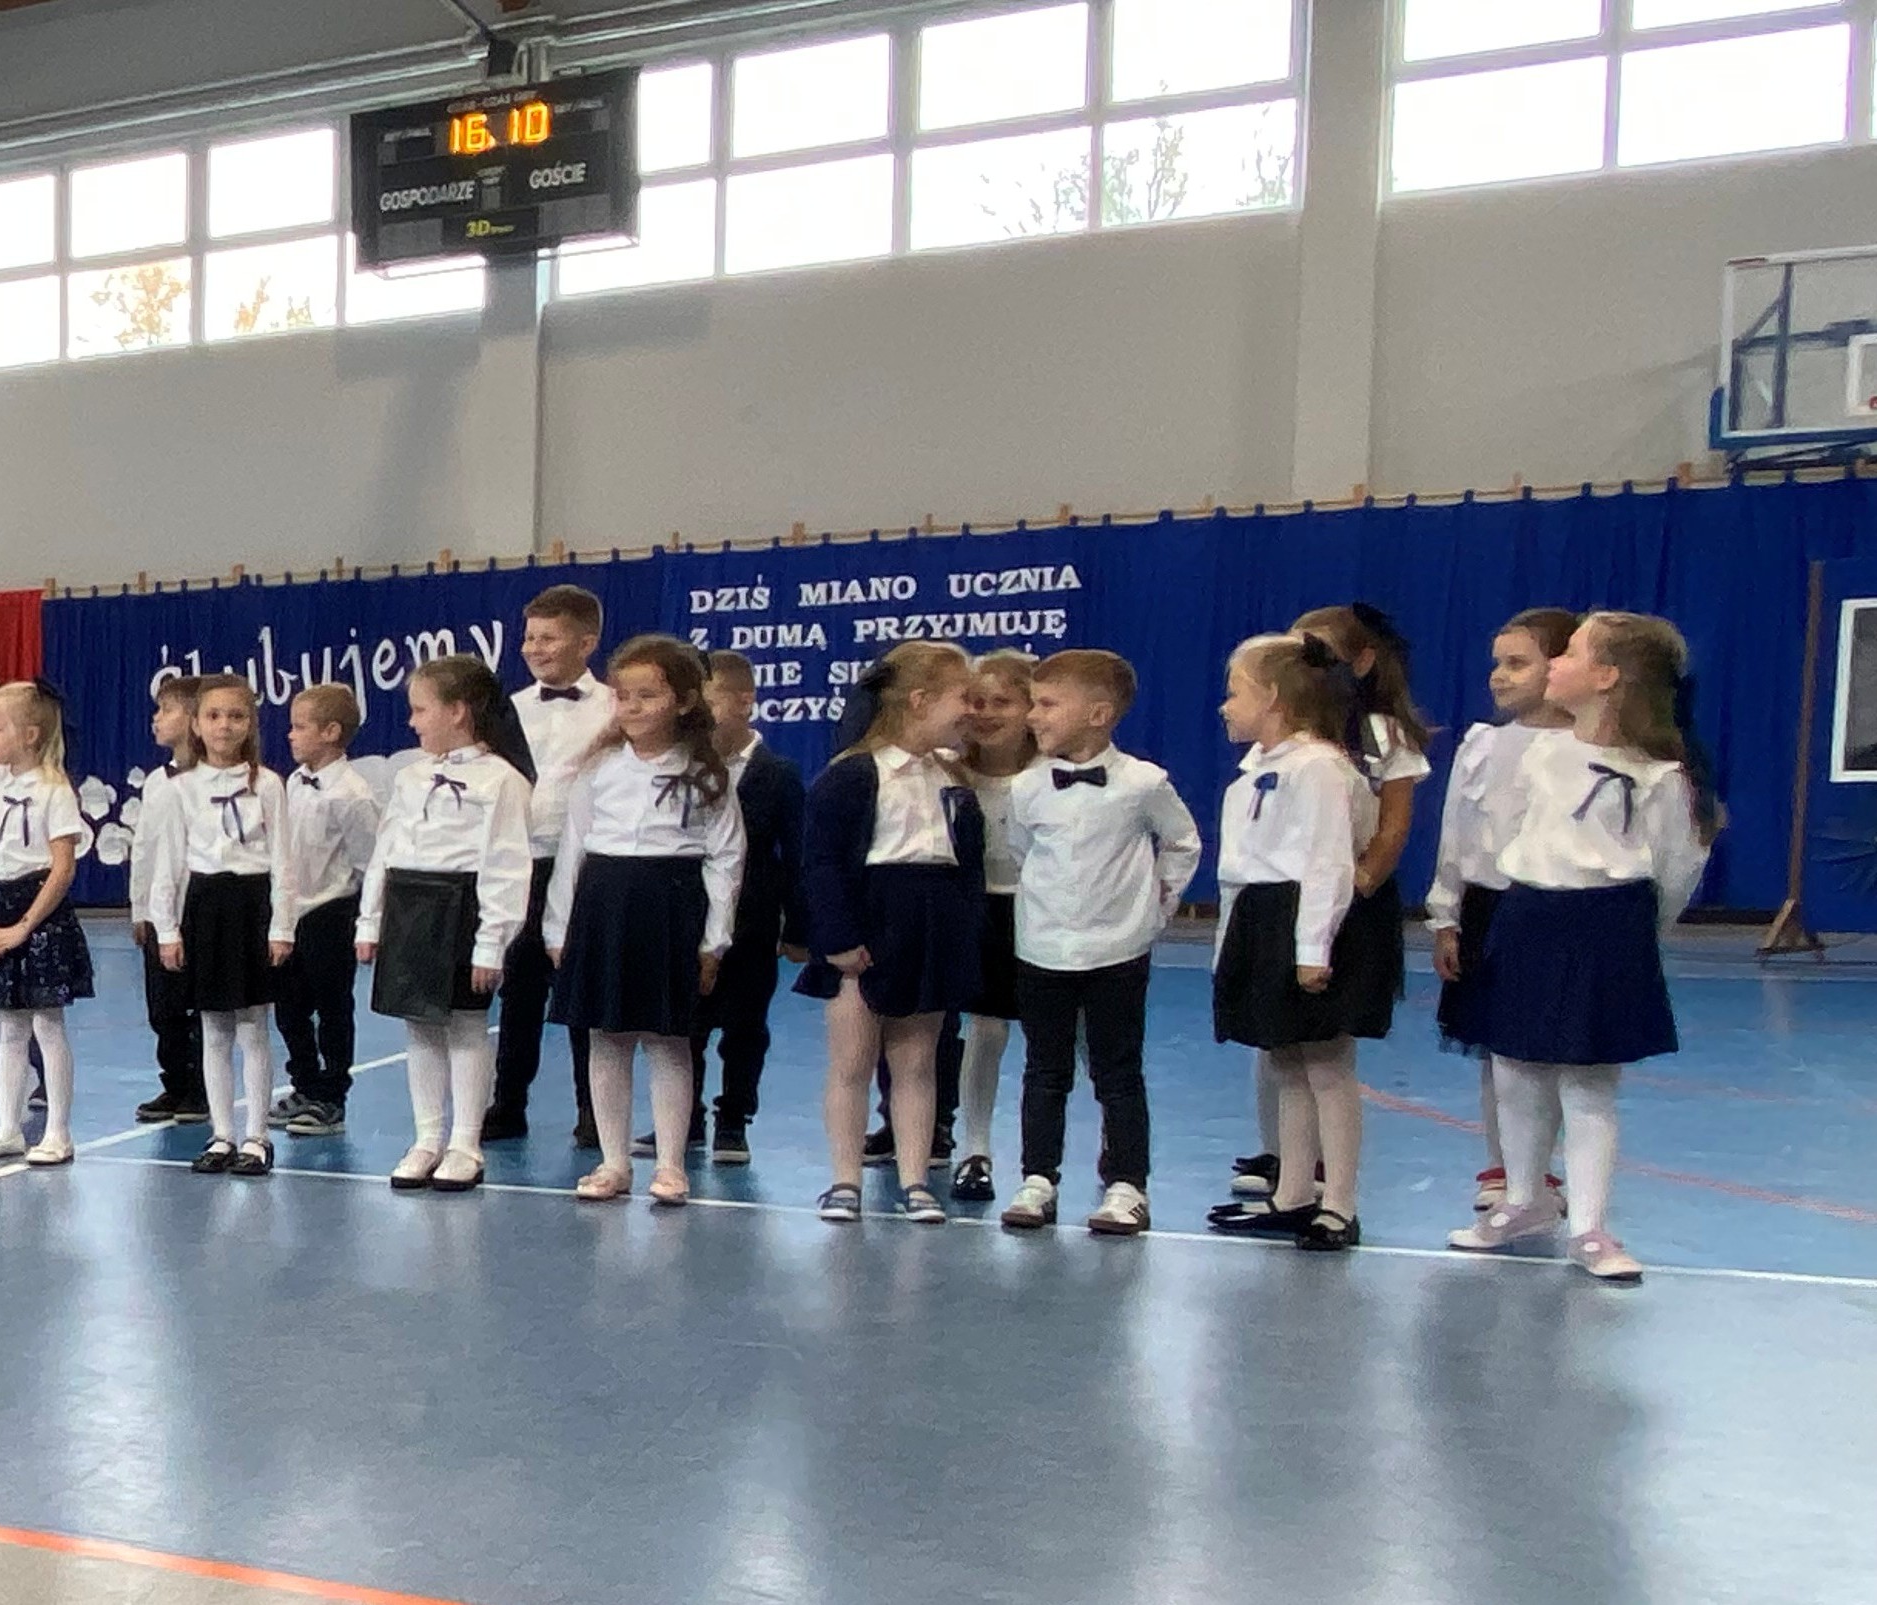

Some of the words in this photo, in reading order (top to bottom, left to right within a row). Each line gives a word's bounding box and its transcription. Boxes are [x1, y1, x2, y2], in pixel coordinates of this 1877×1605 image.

[530, 160, 586, 189] GOŚCIE
[380, 180, 476, 211] GOSPODARZE
[690, 575, 771, 615] DZIŚ
[799, 575, 918, 608] MIANO
[948, 564, 1082, 599] UCZNIA
[690, 628, 710, 650] Z
[730, 623, 827, 650] DUMĄ
[854, 609, 1067, 644] PRZYJMUJĘ
